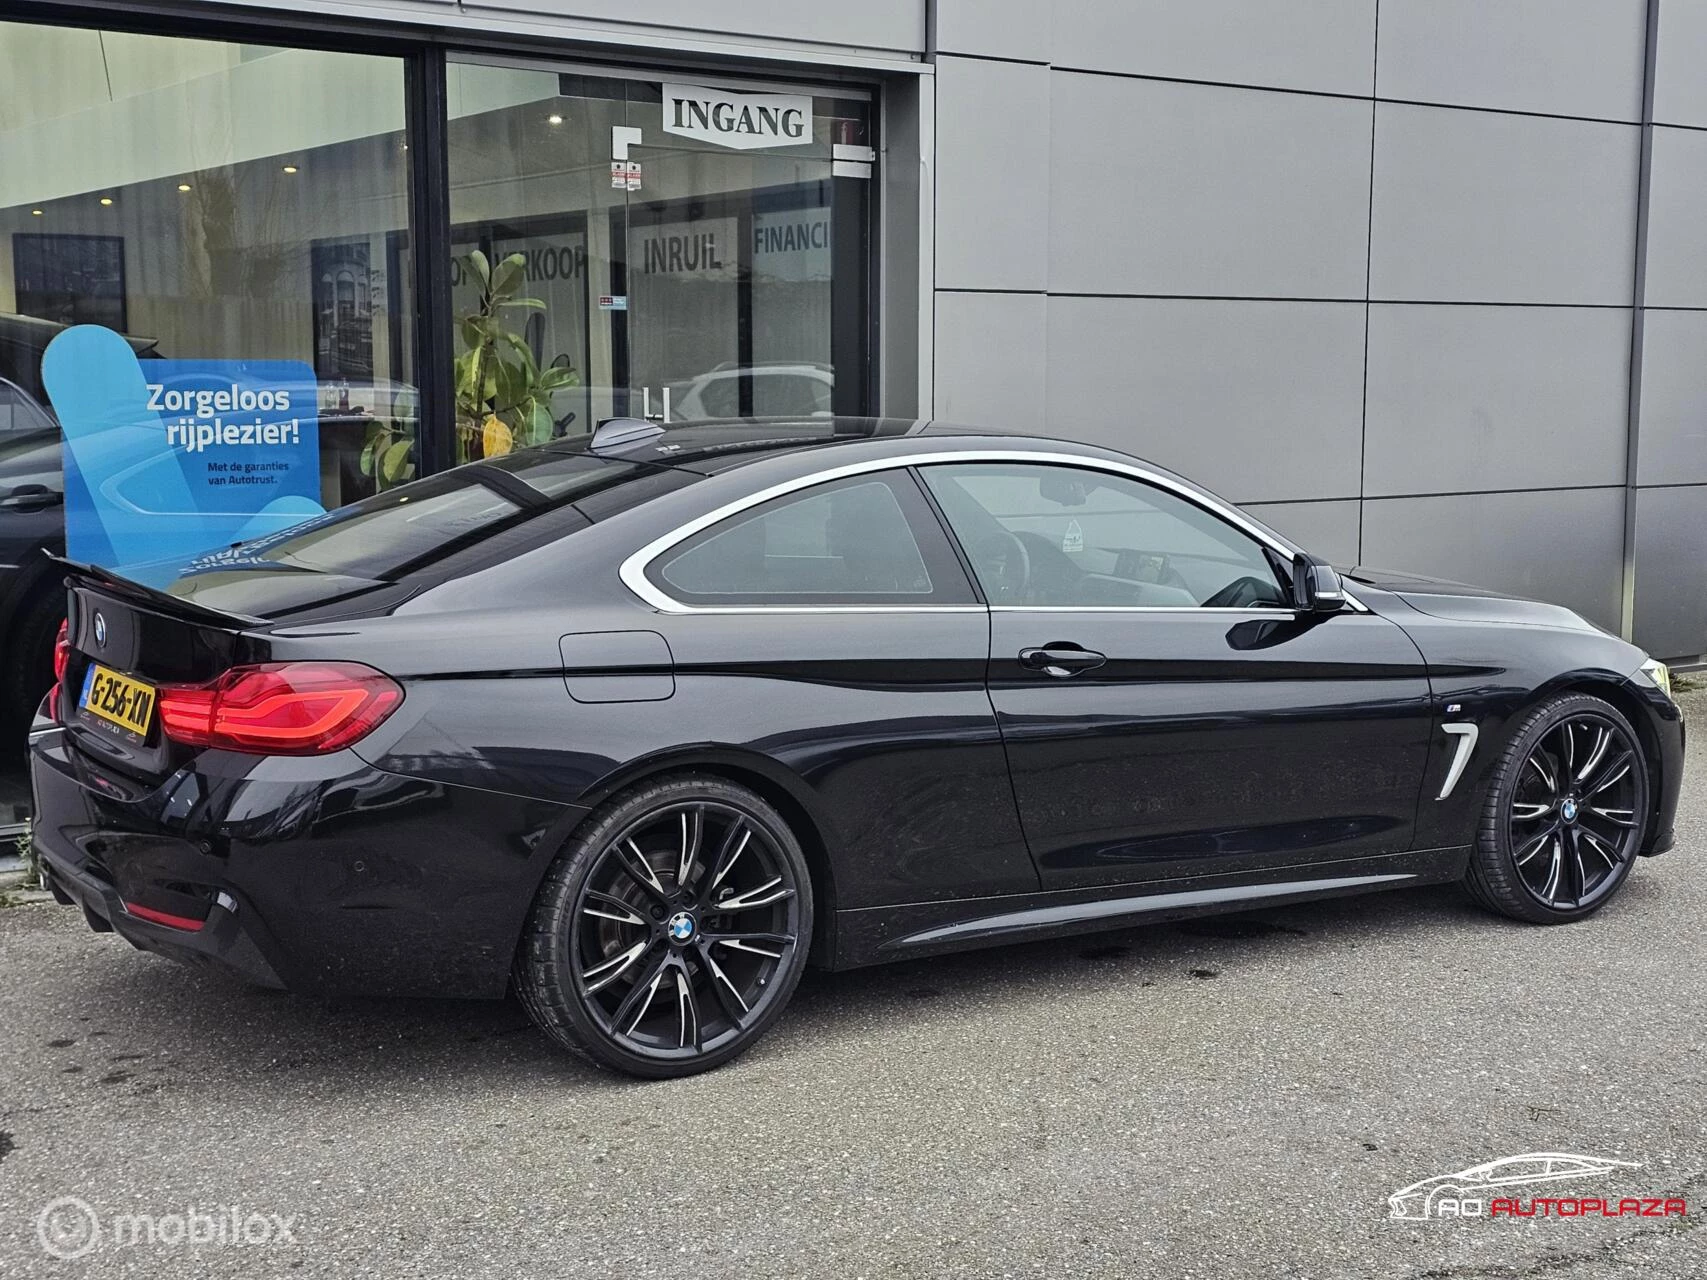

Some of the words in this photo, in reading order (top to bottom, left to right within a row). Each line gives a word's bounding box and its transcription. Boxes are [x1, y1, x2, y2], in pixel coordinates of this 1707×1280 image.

[671, 98, 804, 138] INGANG
[643, 233, 722, 275] INRUIL
[145, 383, 290, 419] Zorgeloos
[166, 418, 300, 453] rijplezier!
[207, 462, 228, 472] Met
[229, 461, 243, 472] de
[244, 461, 289, 474] garanties
[207, 476, 226, 485] van
[228, 474, 278, 486] Autotrust.
[91, 672, 152, 728] G-256-XN
